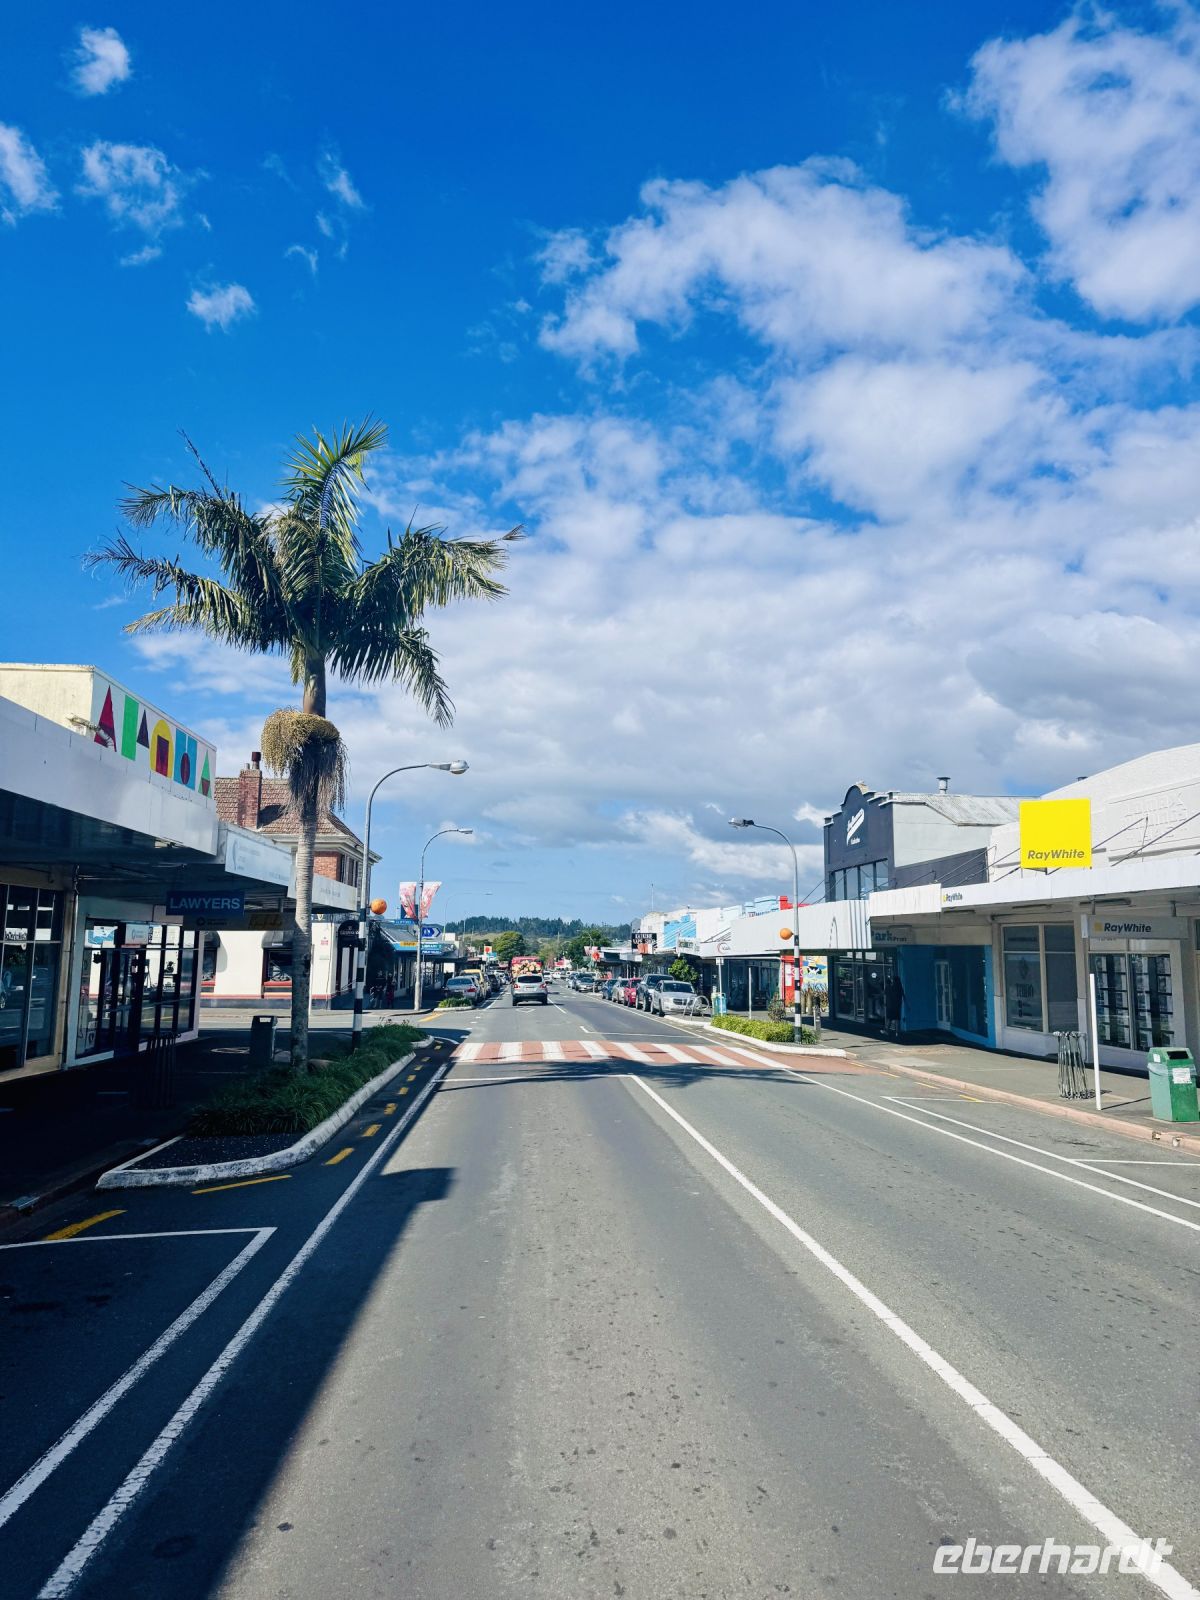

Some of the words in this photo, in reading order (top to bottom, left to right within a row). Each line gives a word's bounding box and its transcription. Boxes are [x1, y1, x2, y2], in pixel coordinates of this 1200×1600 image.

[1027, 848, 1085, 860] RayWhite
[169, 897, 240, 910] LAWYERS
[1104, 922, 1152, 934] RayWhite
